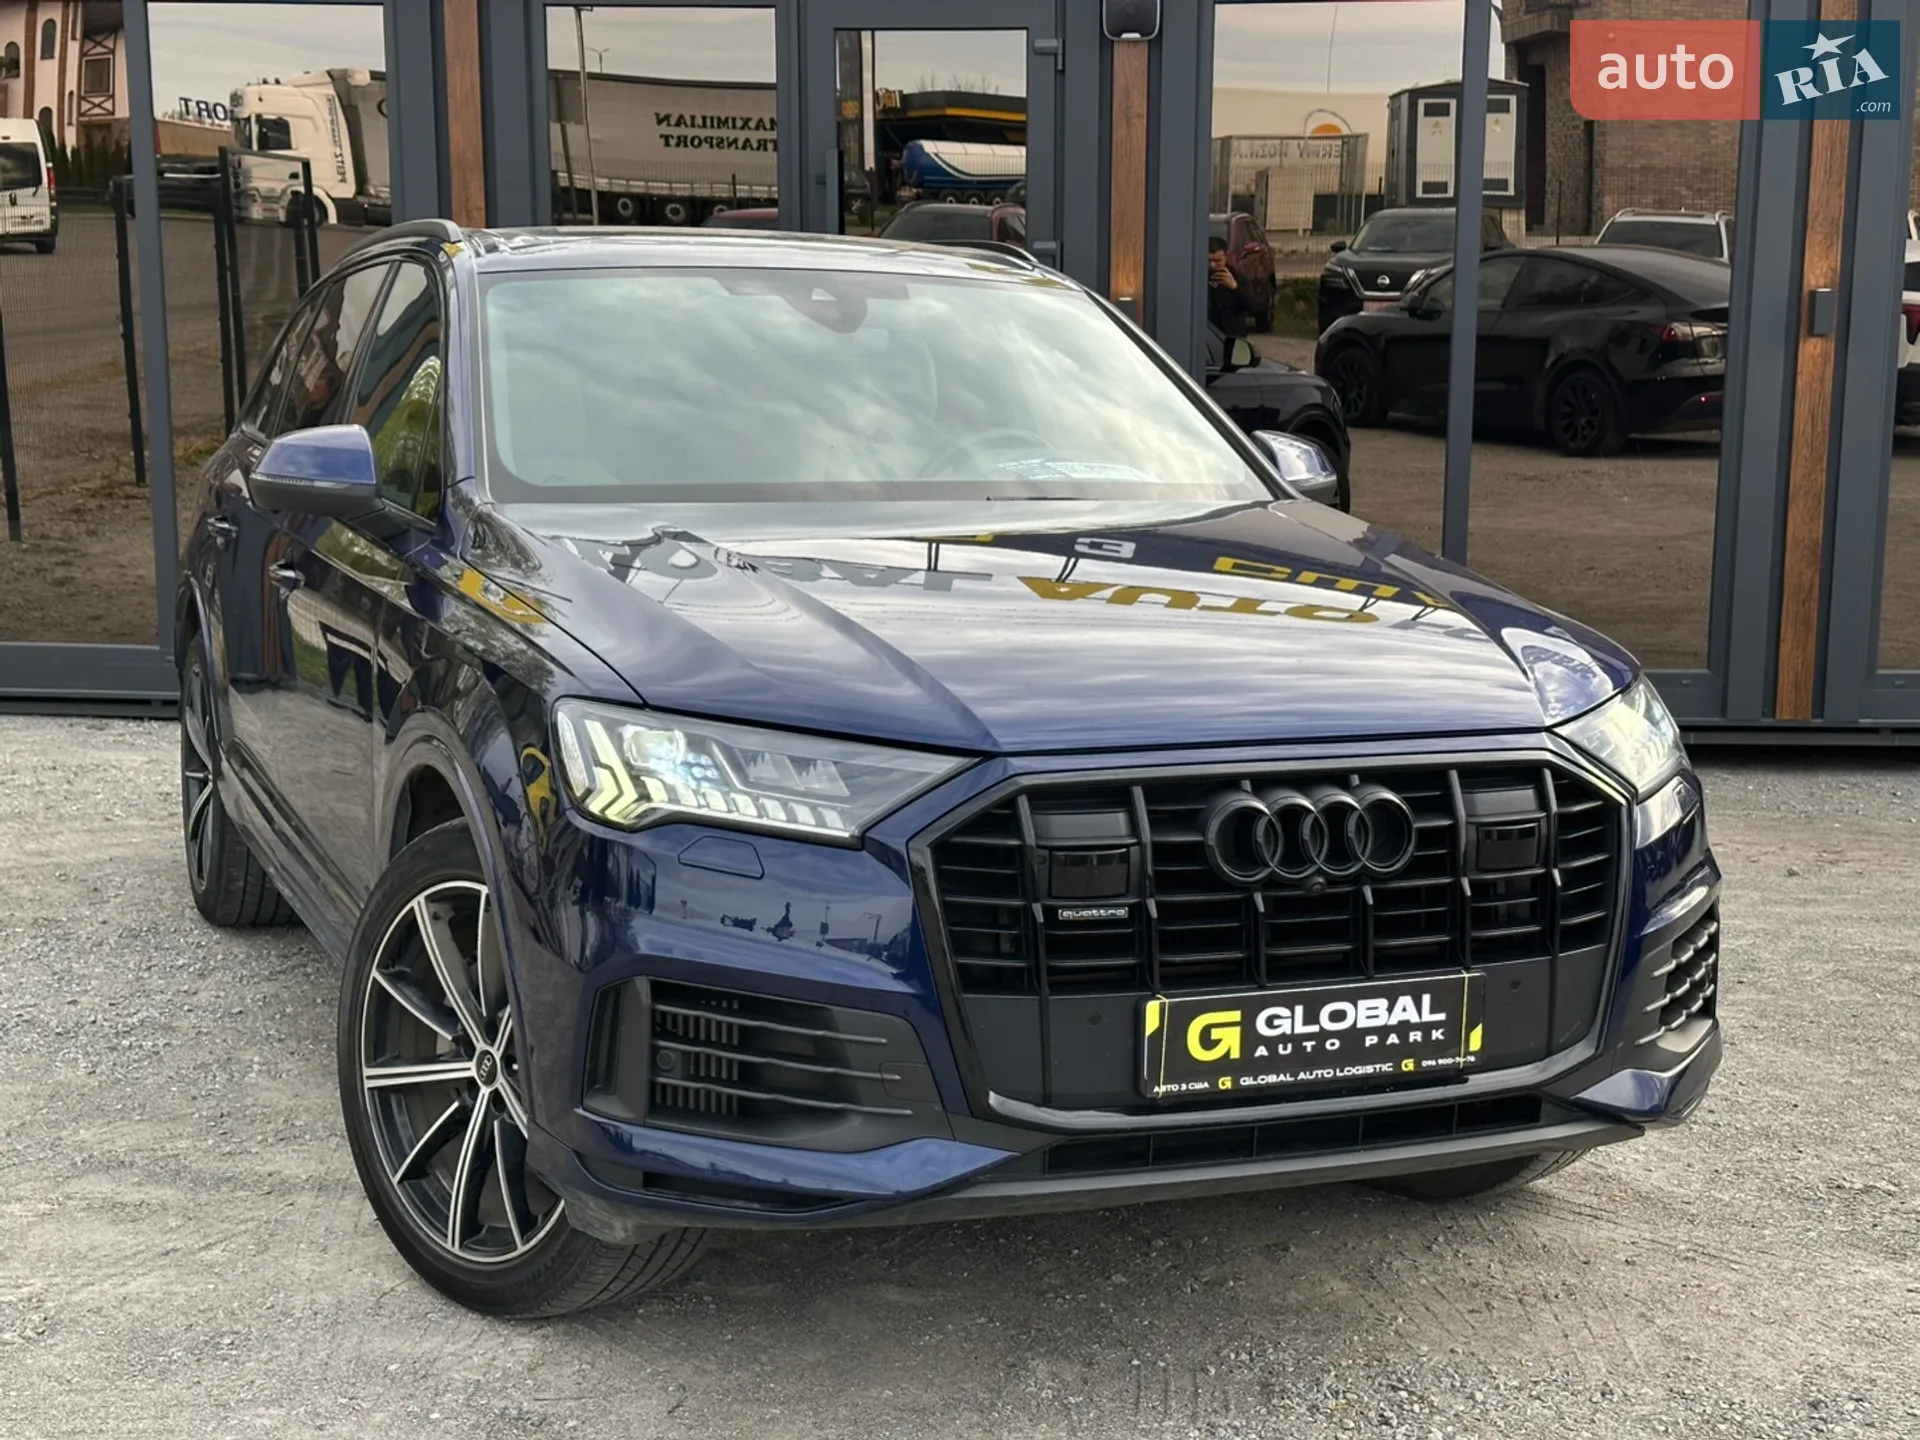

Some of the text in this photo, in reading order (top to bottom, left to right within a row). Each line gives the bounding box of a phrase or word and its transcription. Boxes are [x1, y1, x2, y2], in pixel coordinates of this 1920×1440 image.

[1060, 908, 1126, 919] quattro
[1255, 993, 1447, 1037] GLOBAL
[1254, 1028, 1445, 1058] AUTO PARK
[1239, 1072, 1294, 1086] GLOBAL
[1297, 1068, 1333, 1081] AUTO
[1336, 1063, 1394, 1077] LOGISTIC
